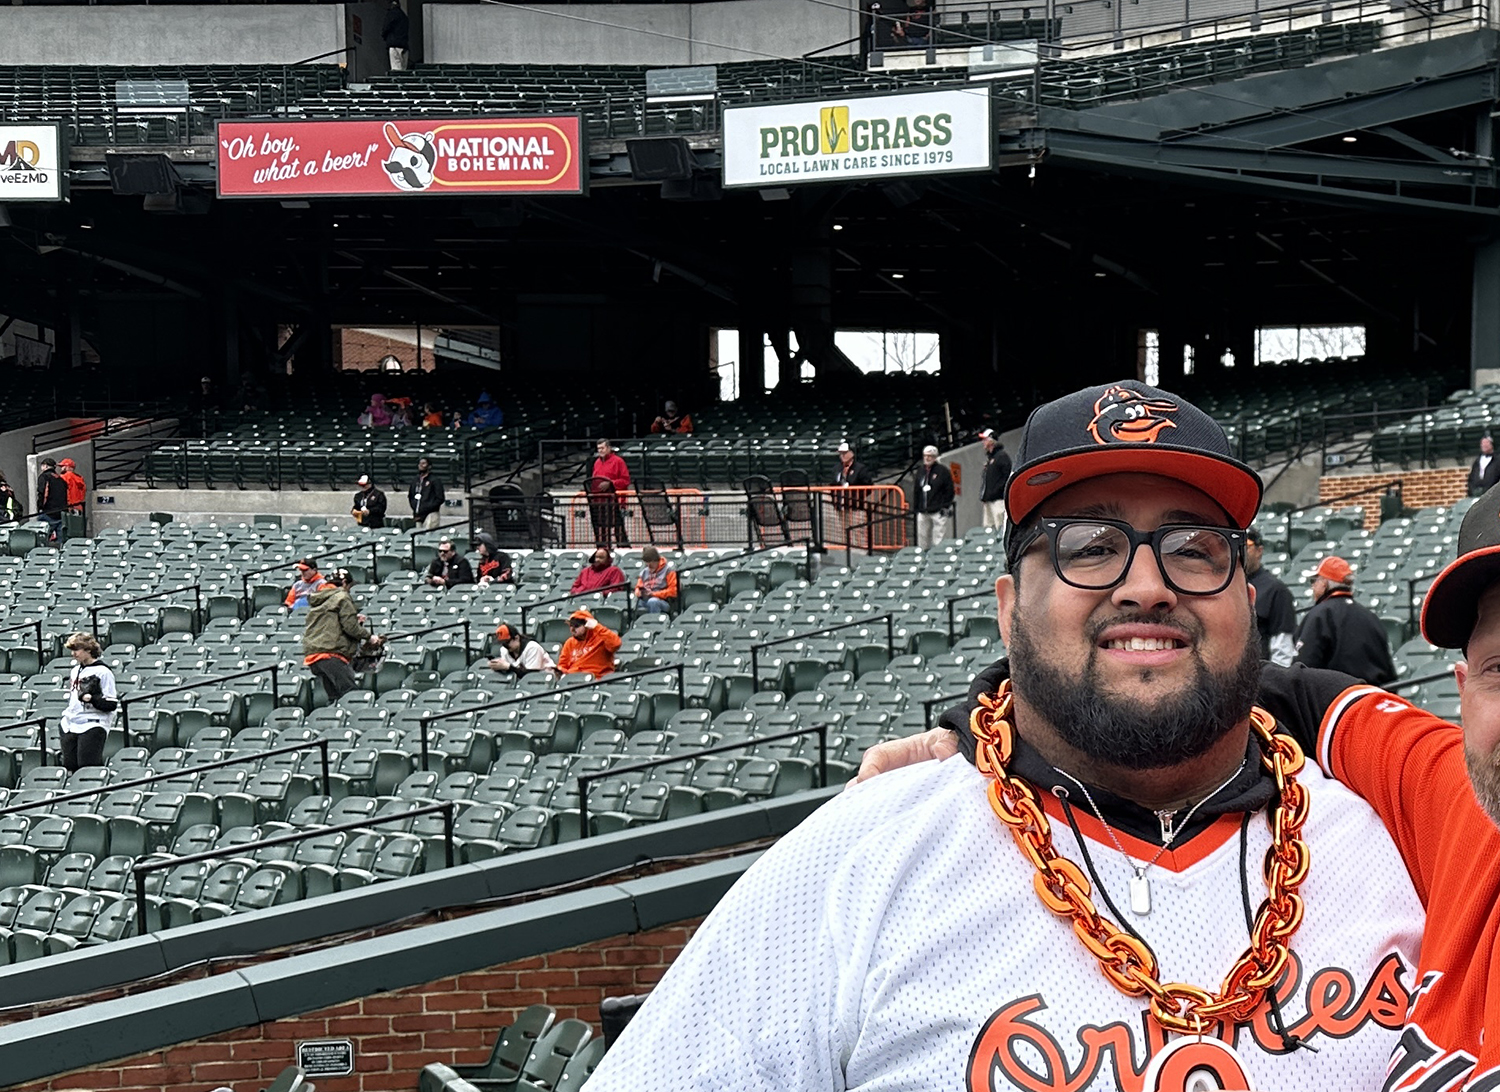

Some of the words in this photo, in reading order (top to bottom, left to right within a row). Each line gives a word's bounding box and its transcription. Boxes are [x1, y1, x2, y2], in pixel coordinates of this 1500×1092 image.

[438, 136, 554, 157] NATIONAL
[760, 123, 818, 158] PRO
[851, 113, 952, 152] GRASS
[253, 158, 300, 184] what
[303, 162, 319, 177] a
[321, 142, 379, 173] beer!"
[760, 161, 800, 176] LOCAL
[803, 158, 840, 173] LAWN
[843, 155, 877, 170] CARE
[881, 153, 920, 168] SINCE
[923, 150, 953, 165] 1979
